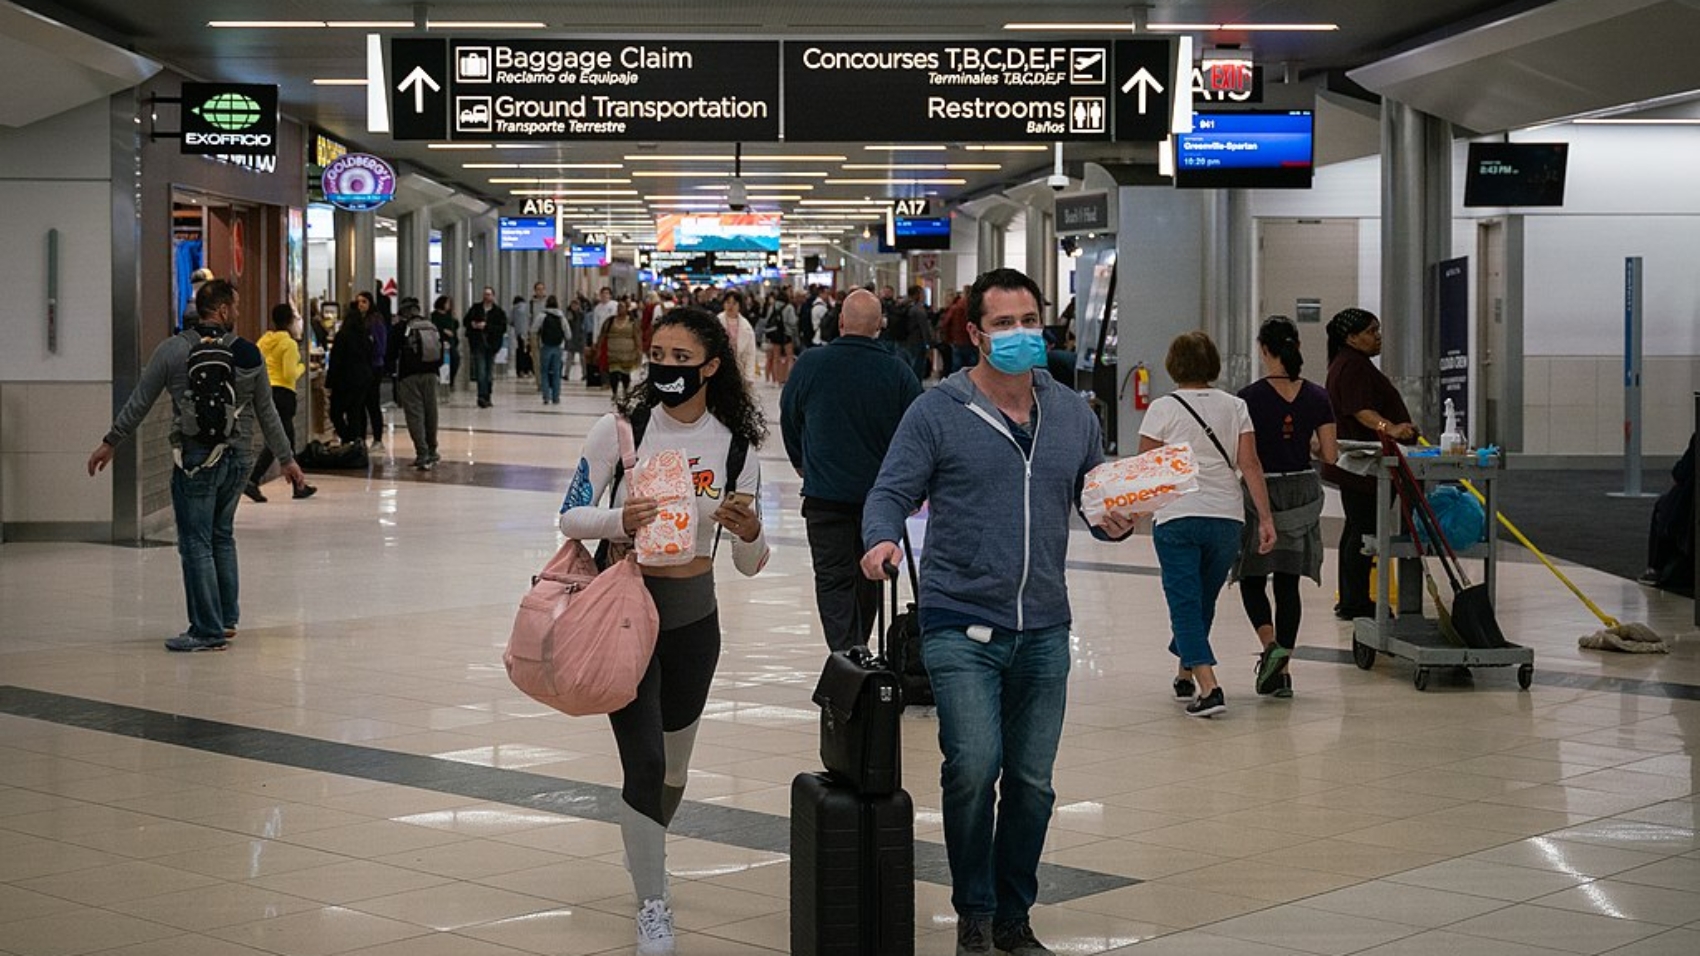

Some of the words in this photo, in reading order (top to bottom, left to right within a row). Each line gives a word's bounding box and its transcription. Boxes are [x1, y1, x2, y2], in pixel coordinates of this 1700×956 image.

[495, 47, 612, 72] Baggage
[620, 46, 693, 69] Claim
[802, 48, 939, 70] Concourses
[945, 48, 1067, 72] T,B,C,D,E,F
[496, 71, 553, 83] Reclamo
[558, 71, 576, 83] de
[579, 71, 639, 86] Equipaje
[927, 71, 998, 84] Terminales
[1211, 64, 1246, 89] EXIT
[495, 96, 586, 118] Ground
[592, 96, 768, 119] Transportation
[928, 97, 1066, 118] Restrooms
[496, 120, 565, 135] Transporte
[569, 120, 626, 134] Terrestre
[1026, 120, 1065, 134] Baños
[185, 132, 272, 147] EXOFFICIO
[326, 155, 392, 181] GOLDBERG'S
[522, 198, 555, 215] A16
[895, 199, 926, 216] A17
